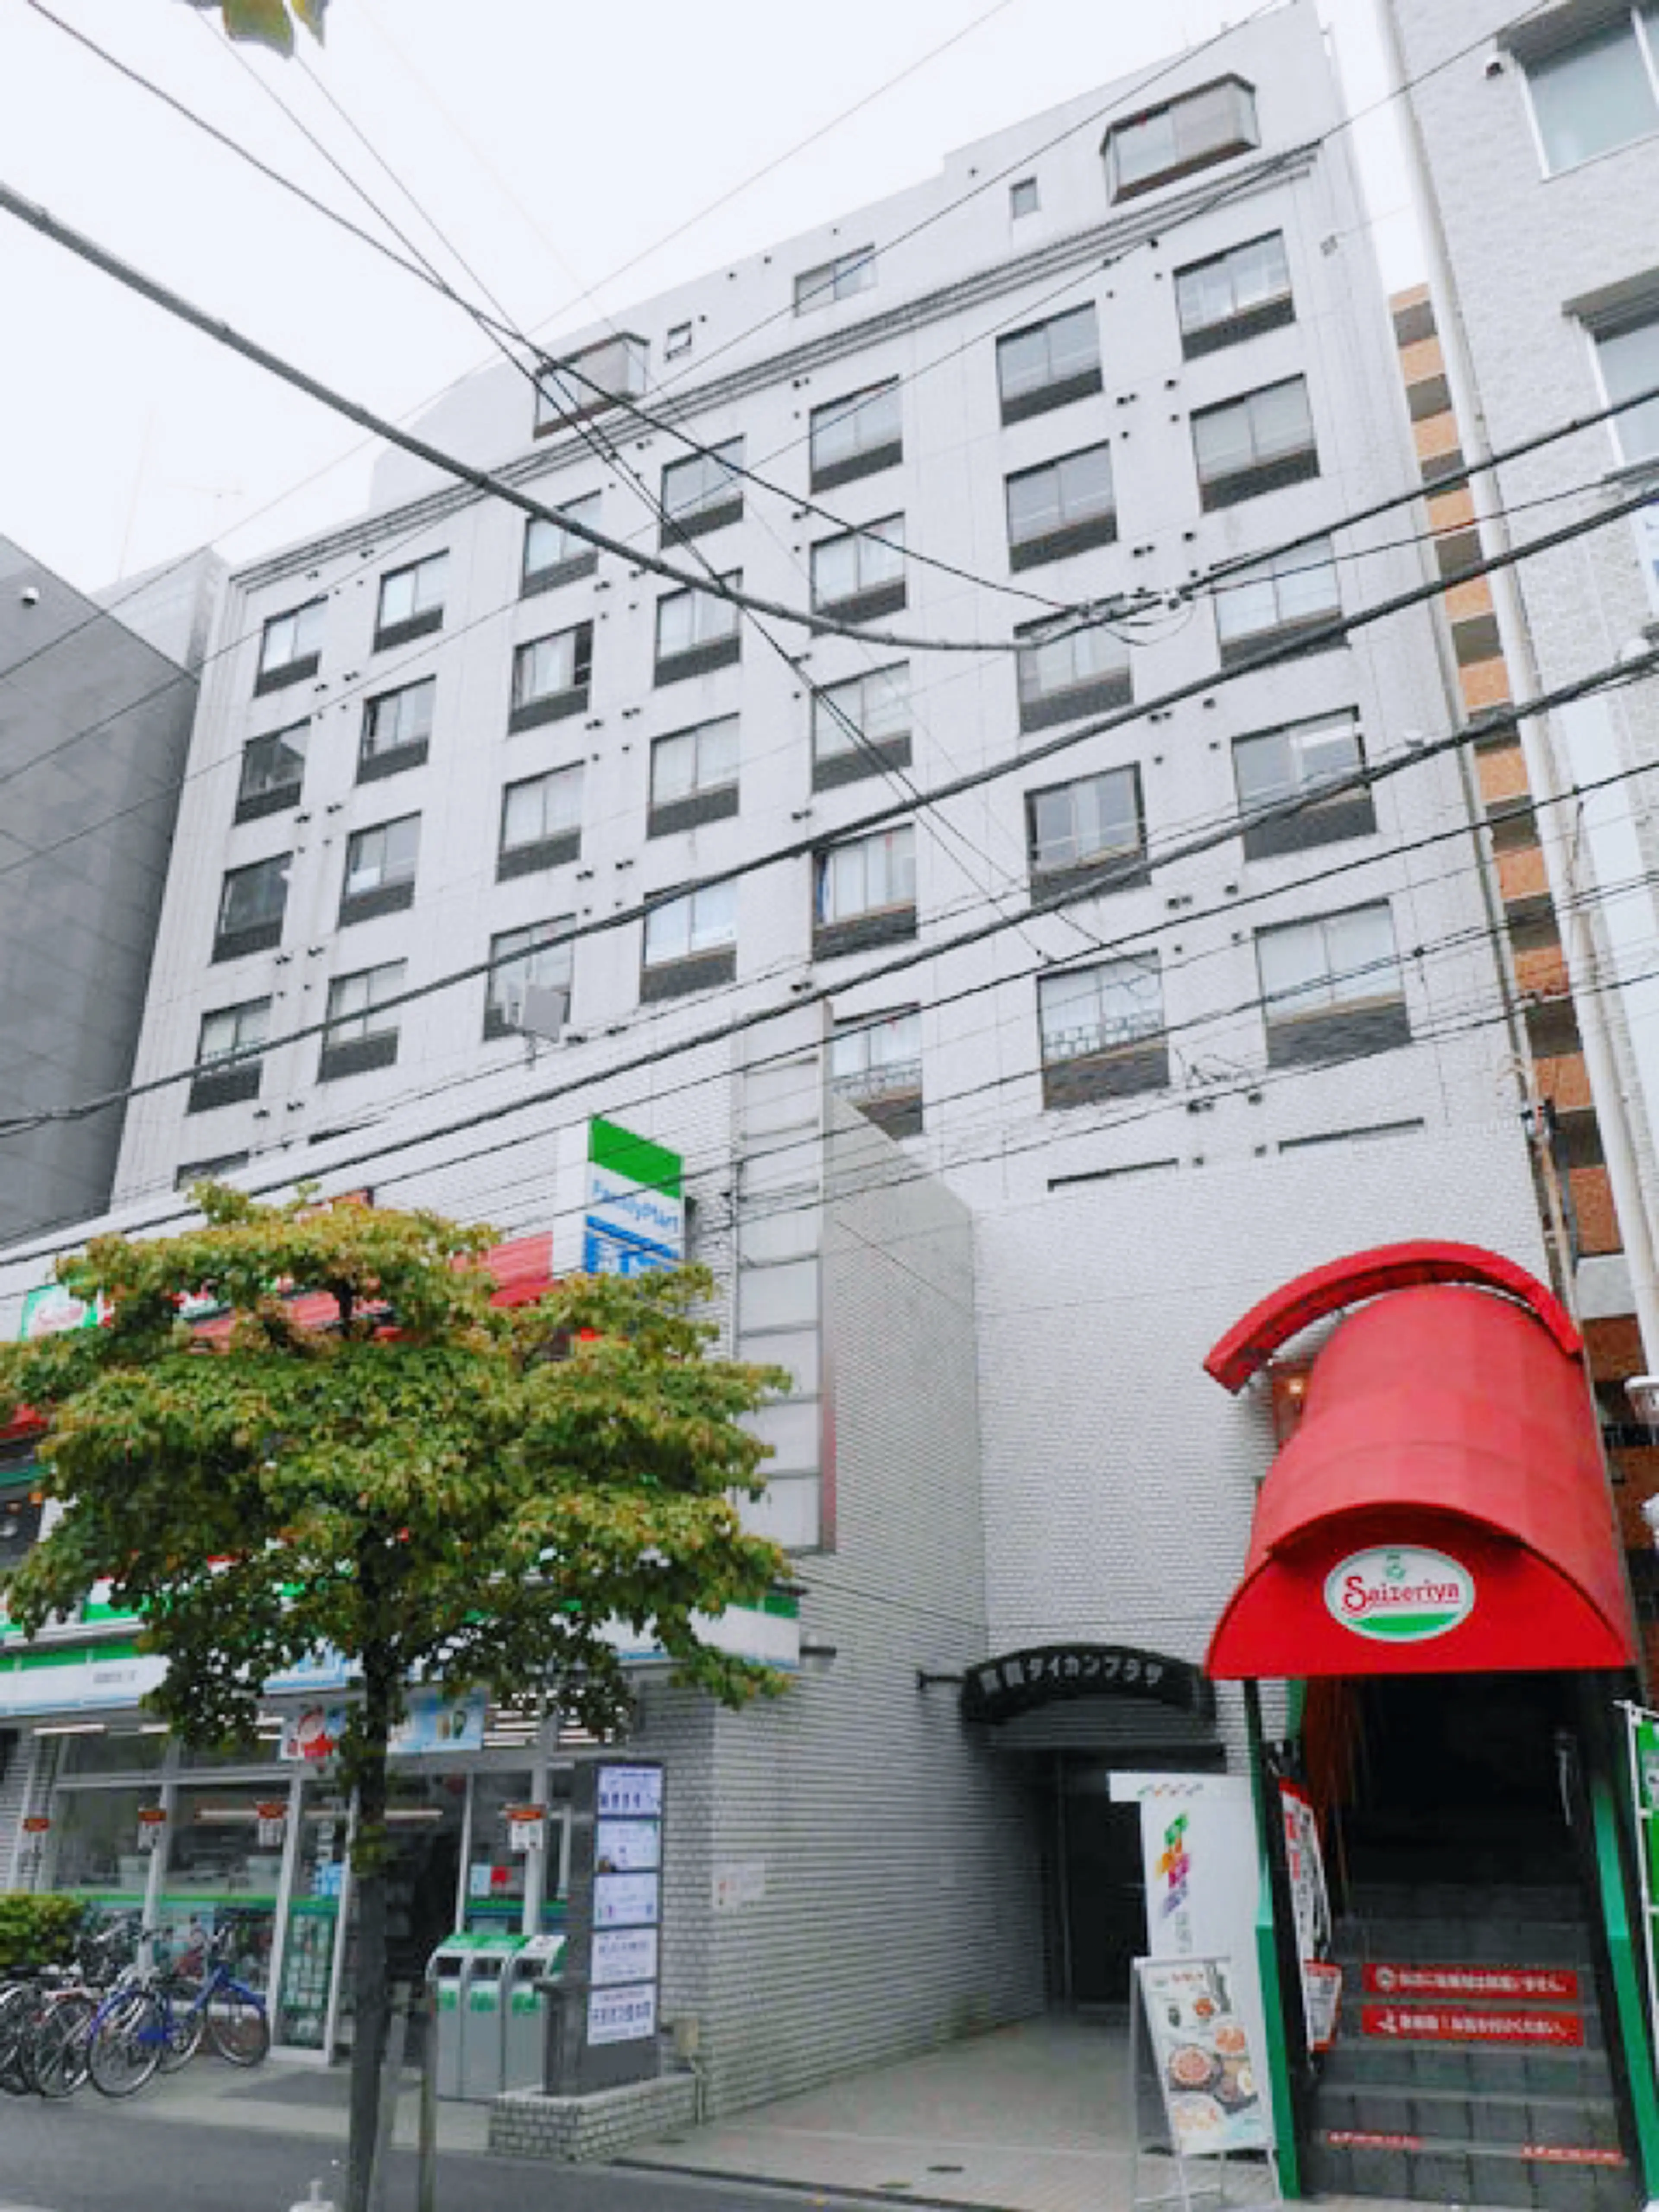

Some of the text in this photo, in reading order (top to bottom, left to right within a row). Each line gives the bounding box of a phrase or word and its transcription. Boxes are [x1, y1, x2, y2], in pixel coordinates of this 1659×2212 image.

[1342, 1575, 1460, 1612] Saizeriya
[979, 1654, 1163, 1695] ダイカンプラザ
